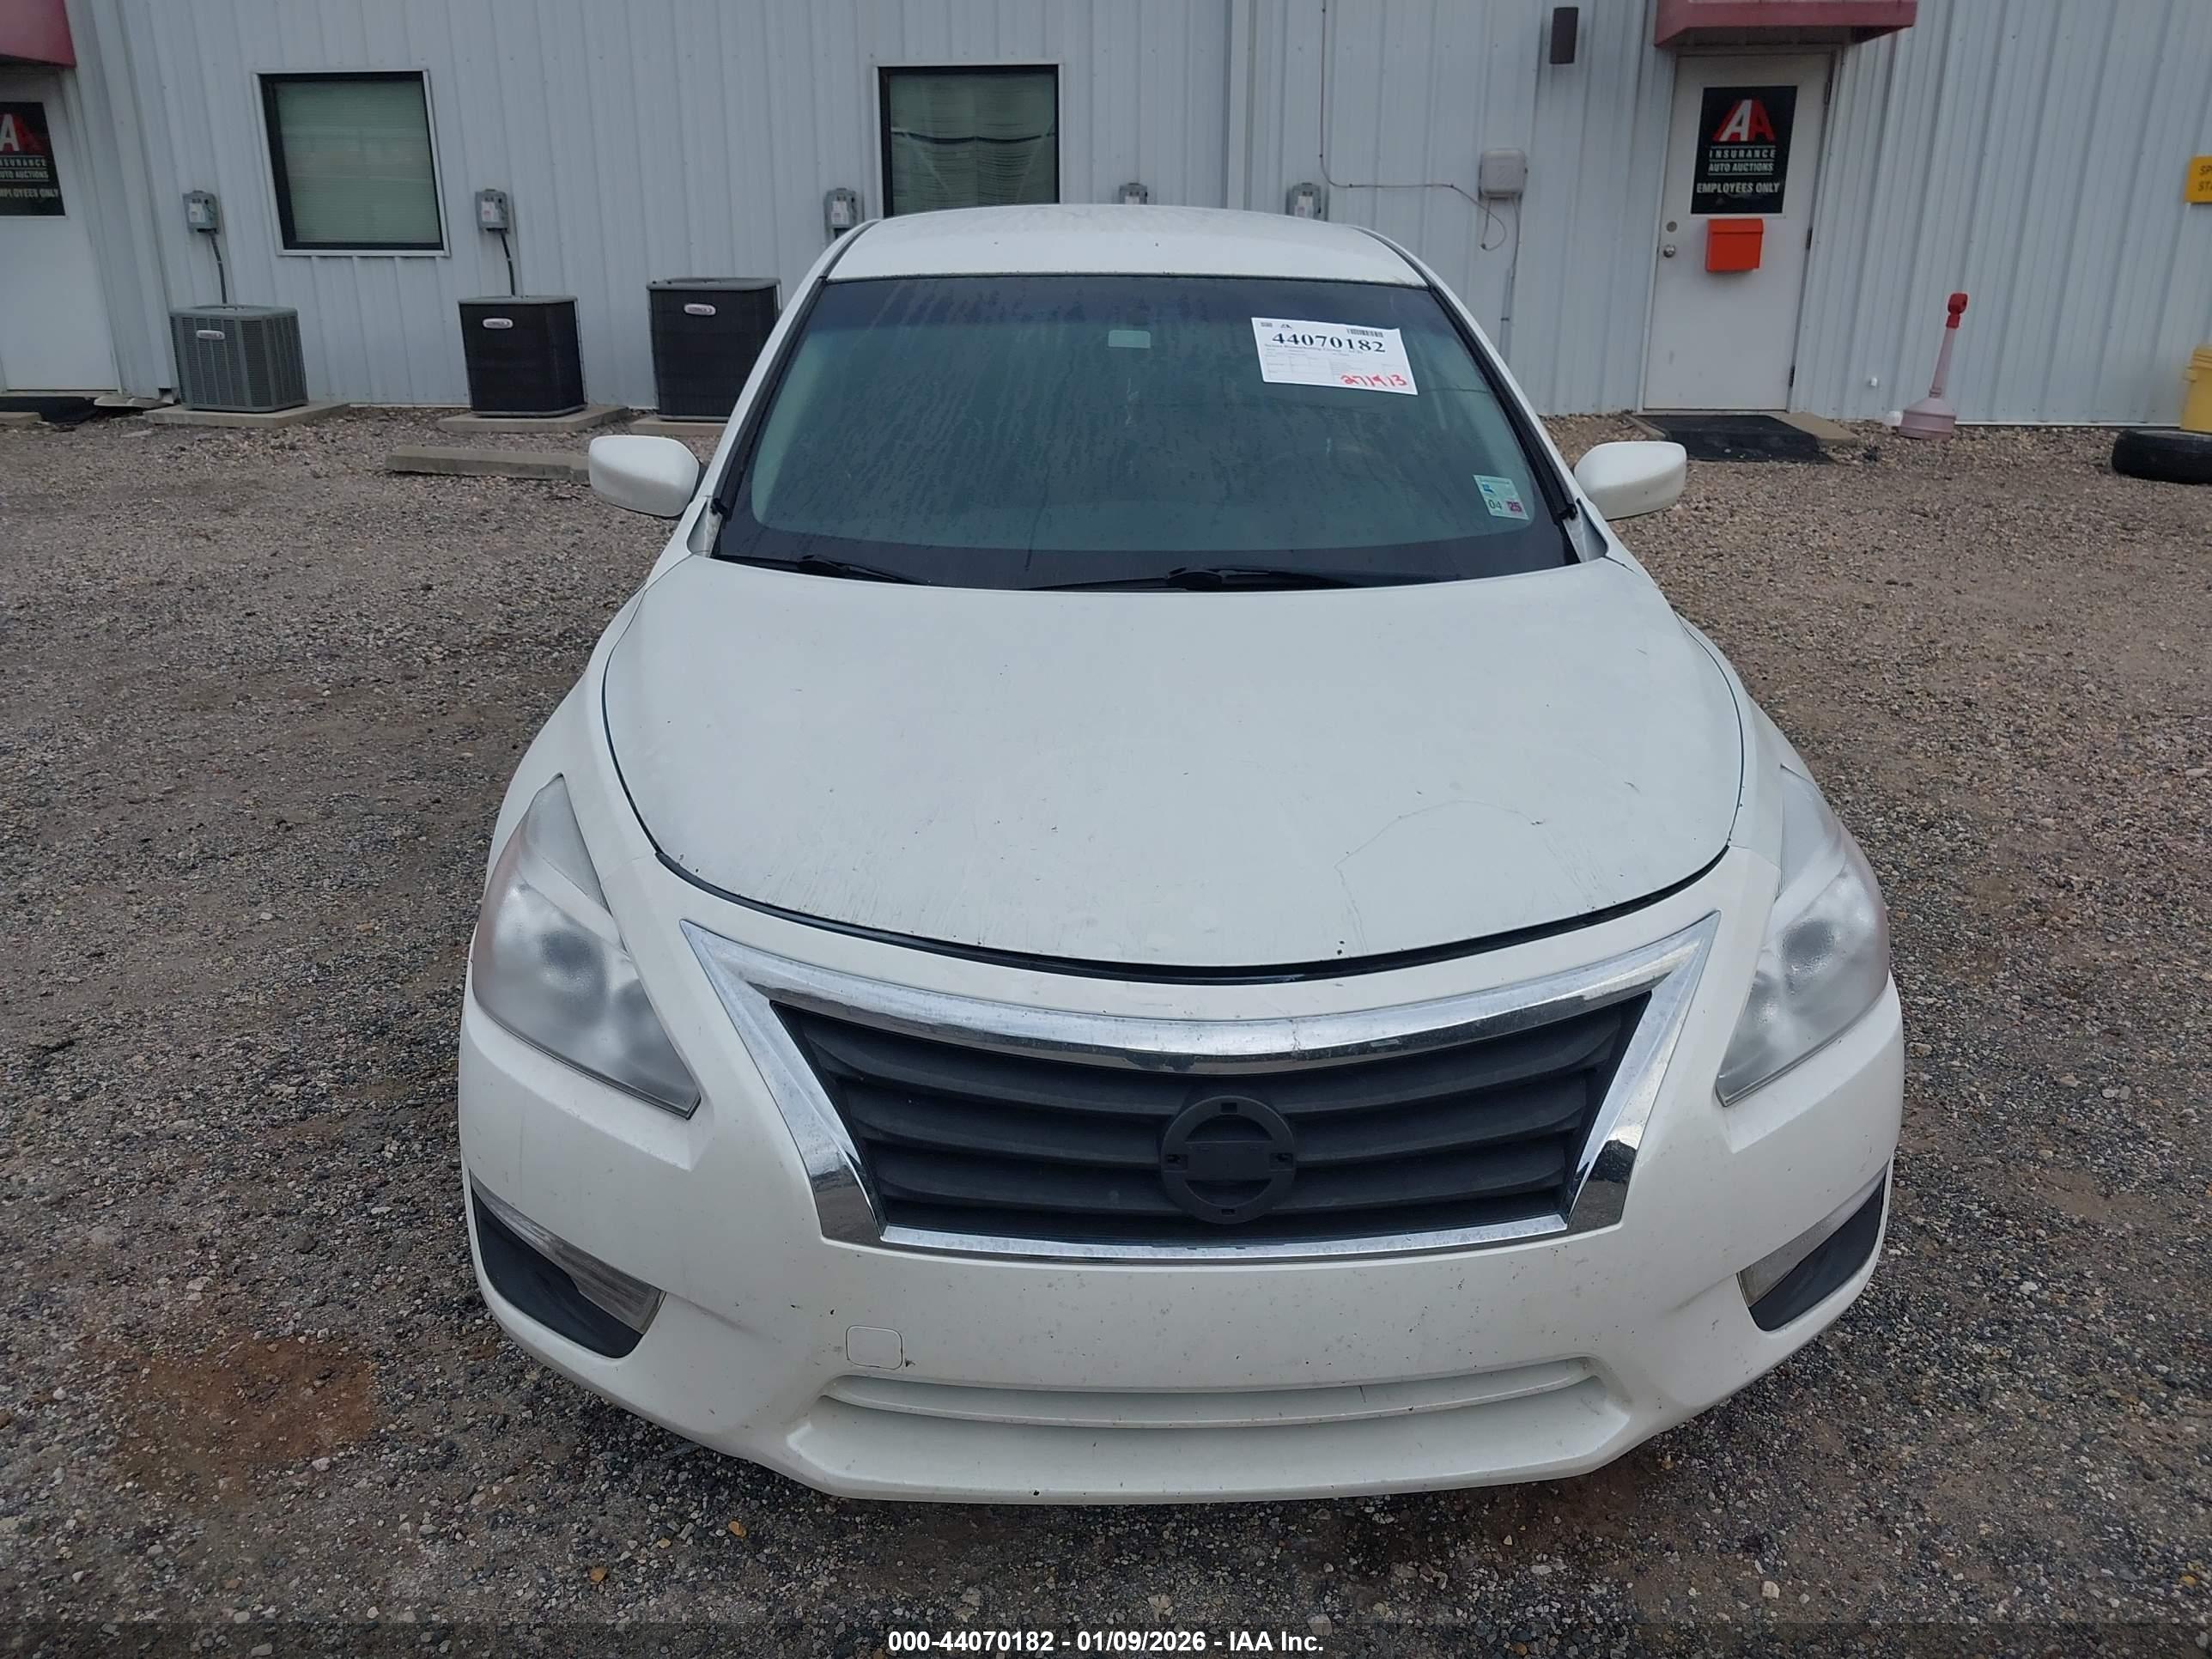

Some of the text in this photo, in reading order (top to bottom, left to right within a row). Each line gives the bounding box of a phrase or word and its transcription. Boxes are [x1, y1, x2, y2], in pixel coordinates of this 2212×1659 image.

[1709, 149, 1776, 159] INSURANCE
[1708, 162, 1774, 173] AUTO AUCTIONS
[15, 170, 49, 179] AUCTIONS
[1696, 181, 1781, 193] EMPLOYEES ONLY
[39, 188, 59, 198] ONLY
[1272, 332, 1386, 353] 44070182
[1488, 499, 1522, 513] 04 25
